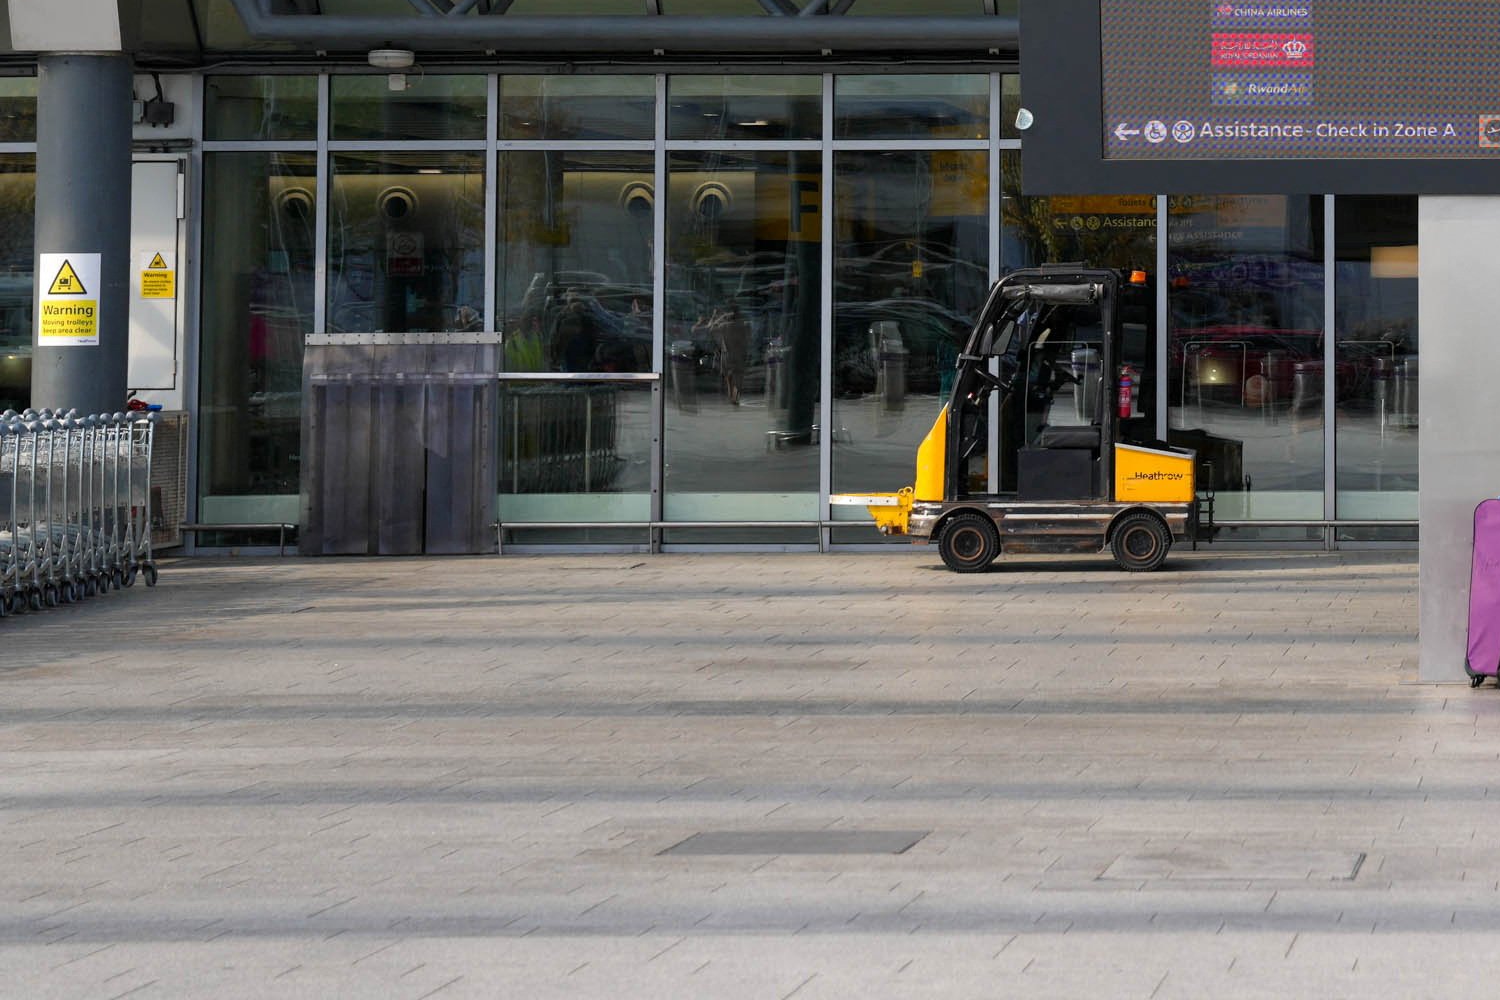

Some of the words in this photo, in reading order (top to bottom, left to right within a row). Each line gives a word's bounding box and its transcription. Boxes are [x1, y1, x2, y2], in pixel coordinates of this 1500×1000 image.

[1234, 8, 1265, 16] CHINA
[1266, 8, 1308, 16] AIRLINES
[1200, 121, 1303, 137] Assistance
[1316, 122, 1367, 137] Check
[1373, 123, 1389, 137] in
[1394, 123, 1438, 137] Zone
[1443, 124, 1457, 137] A
[1103, 216, 1158, 228] Assistanc
[43, 304, 94, 318] Warning
[1135, 471, 1183, 481] Heathrow
